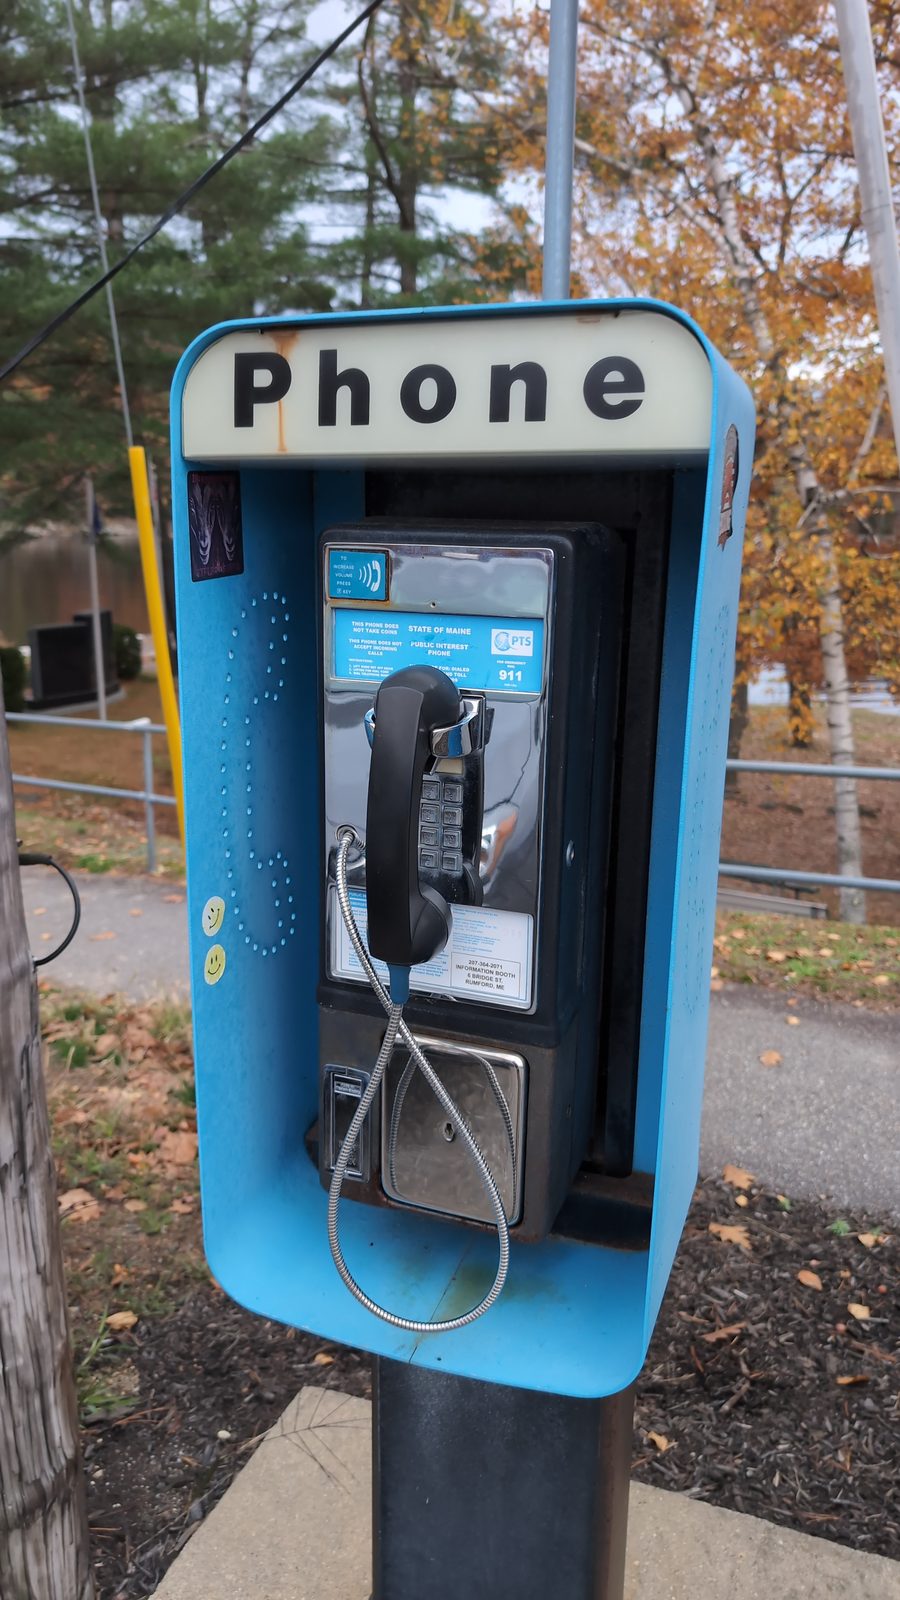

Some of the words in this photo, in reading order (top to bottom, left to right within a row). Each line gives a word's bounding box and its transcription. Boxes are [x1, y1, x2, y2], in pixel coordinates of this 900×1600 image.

[233, 348, 646, 428] Phone
[512, 636, 531, 646] PTS
[499, 670, 522, 681] 911
[456, 964, 494, 975] INFORMATION
[495, 971, 515, 979] BOOTH
